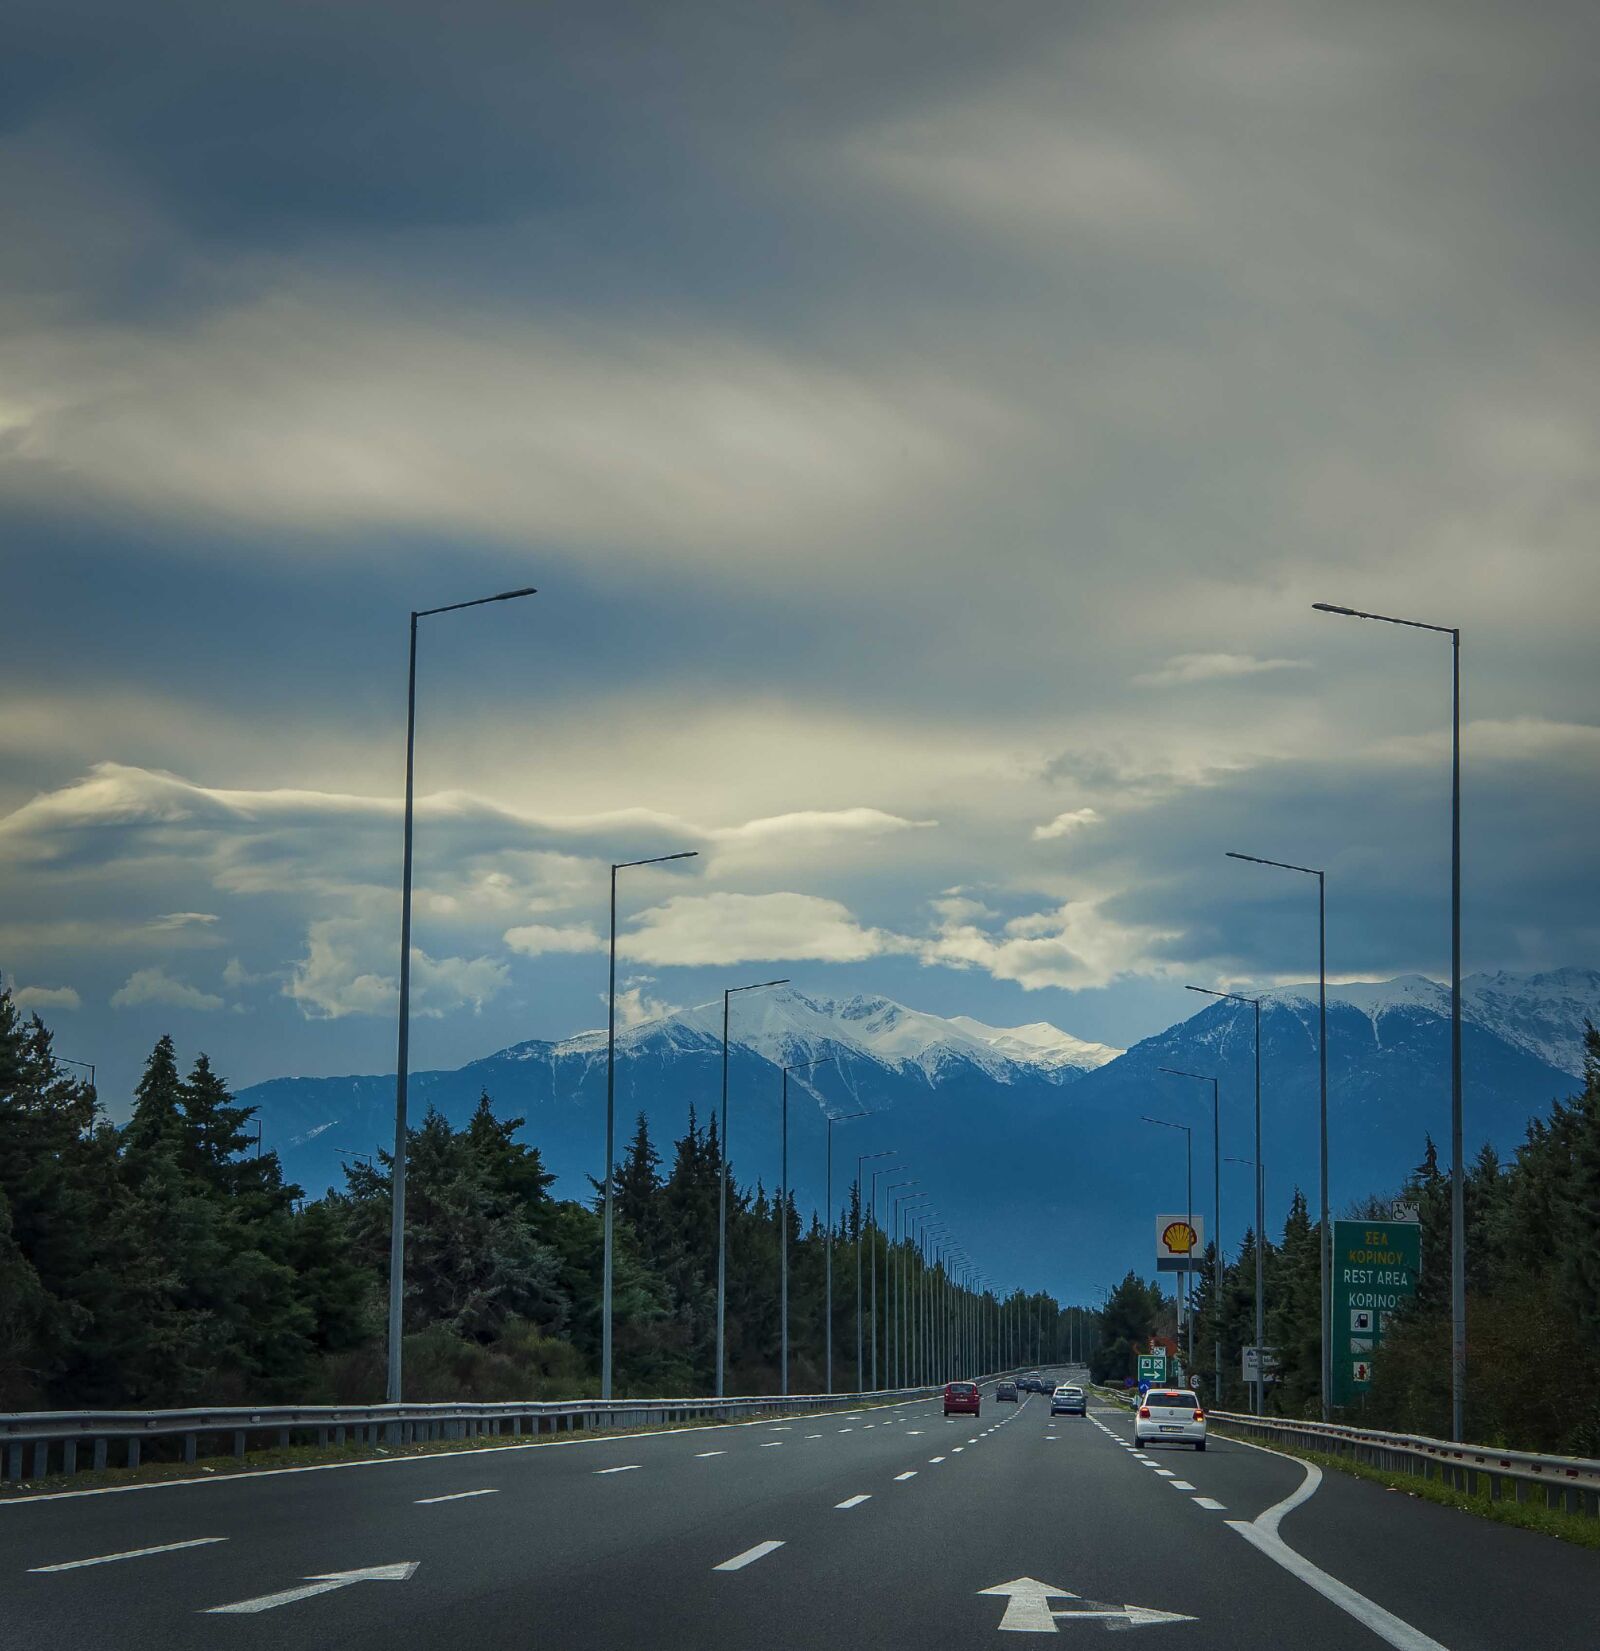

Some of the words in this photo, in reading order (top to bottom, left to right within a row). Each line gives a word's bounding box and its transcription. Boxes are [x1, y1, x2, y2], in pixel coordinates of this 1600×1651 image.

[1403, 1203, 1418, 1211] WC
[1344, 1269, 1374, 1284] REST
[1376, 1271, 1408, 1286] AREA
